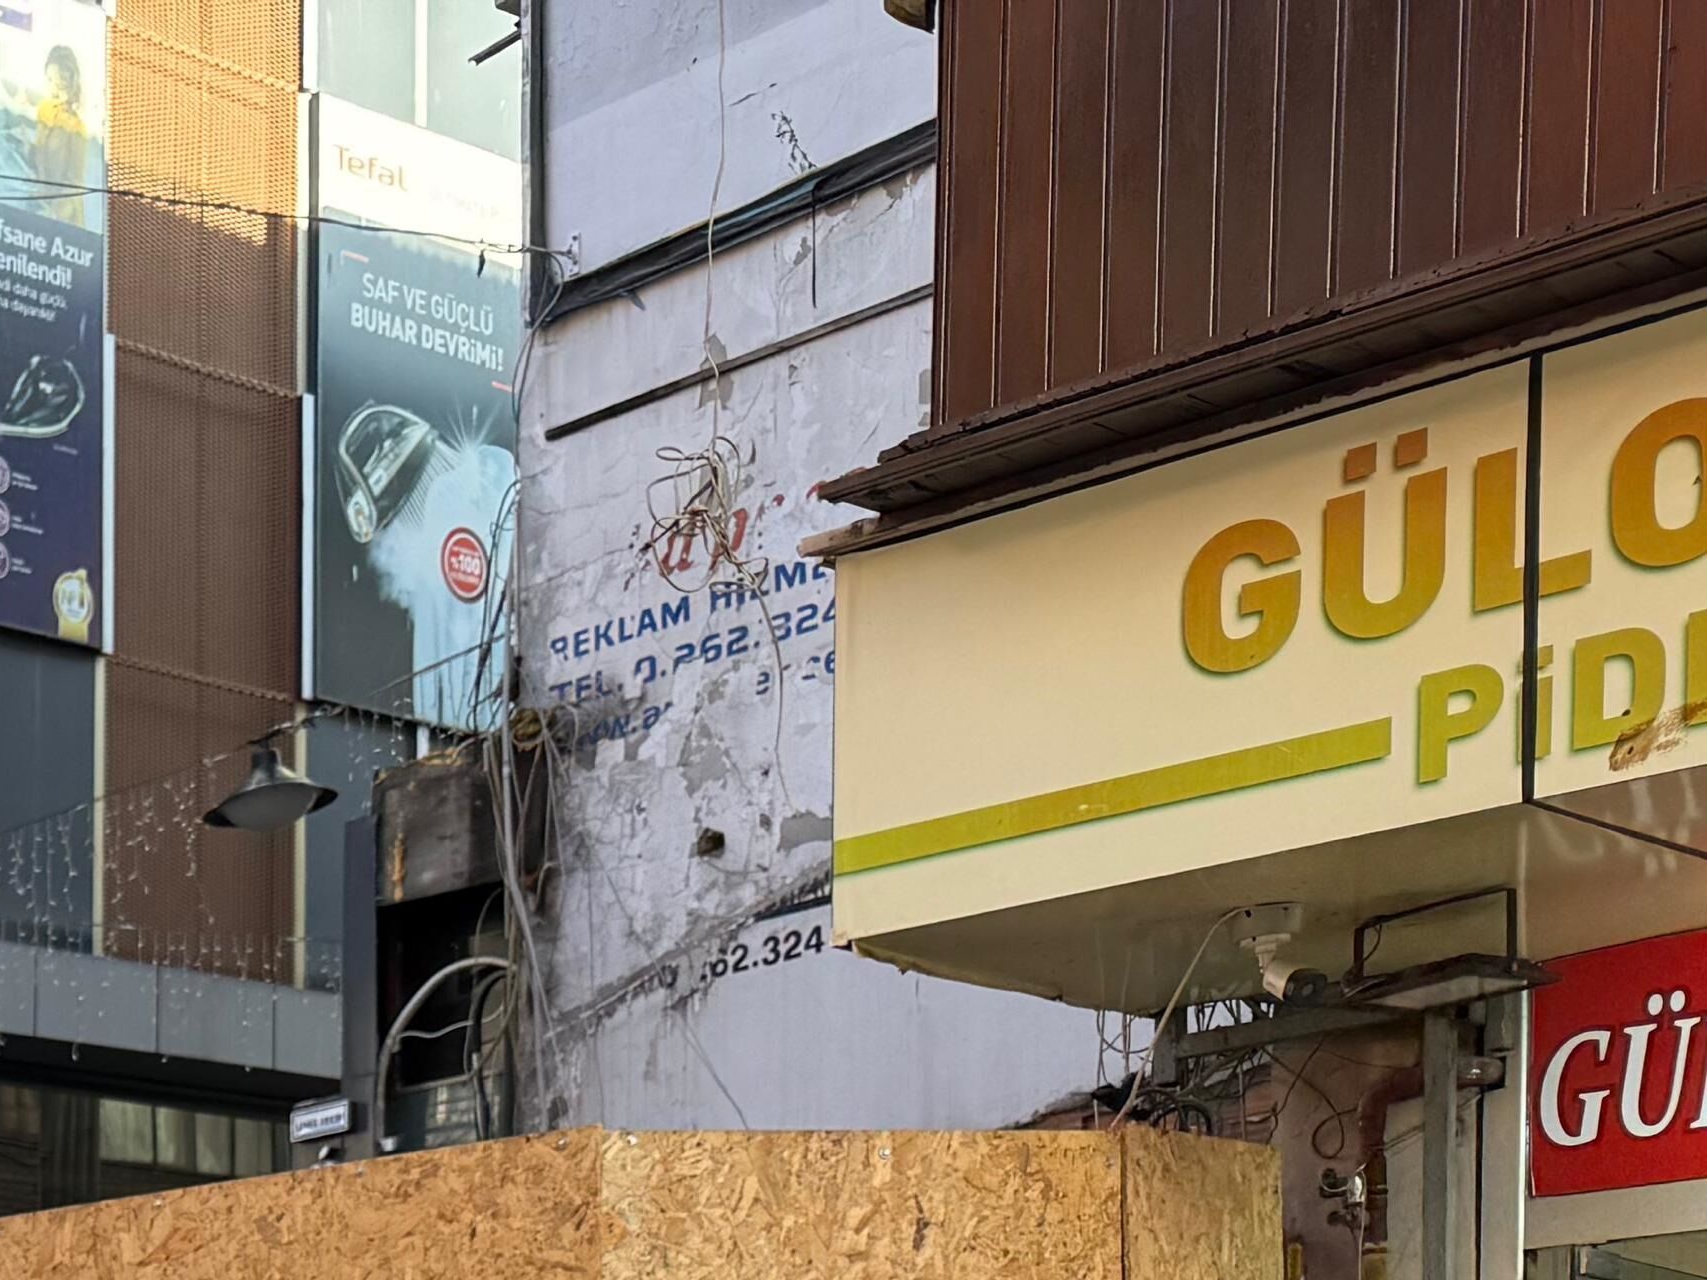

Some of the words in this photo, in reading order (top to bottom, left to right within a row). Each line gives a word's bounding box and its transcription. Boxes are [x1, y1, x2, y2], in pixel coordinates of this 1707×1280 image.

[333, 144, 407, 192] Tefal
[50, 236, 94, 267] Azur
[362, 272, 401, 305] SAF
[403, 284, 427, 316] VE
[430, 292, 494, 336] GÜÇLÜ
[350, 302, 418, 346] BUHAR
[421, 323, 505, 372] DEVRİMİ!
[549, 595, 691, 662] REKLAM
[1418, 607, 1707, 786] PİD
